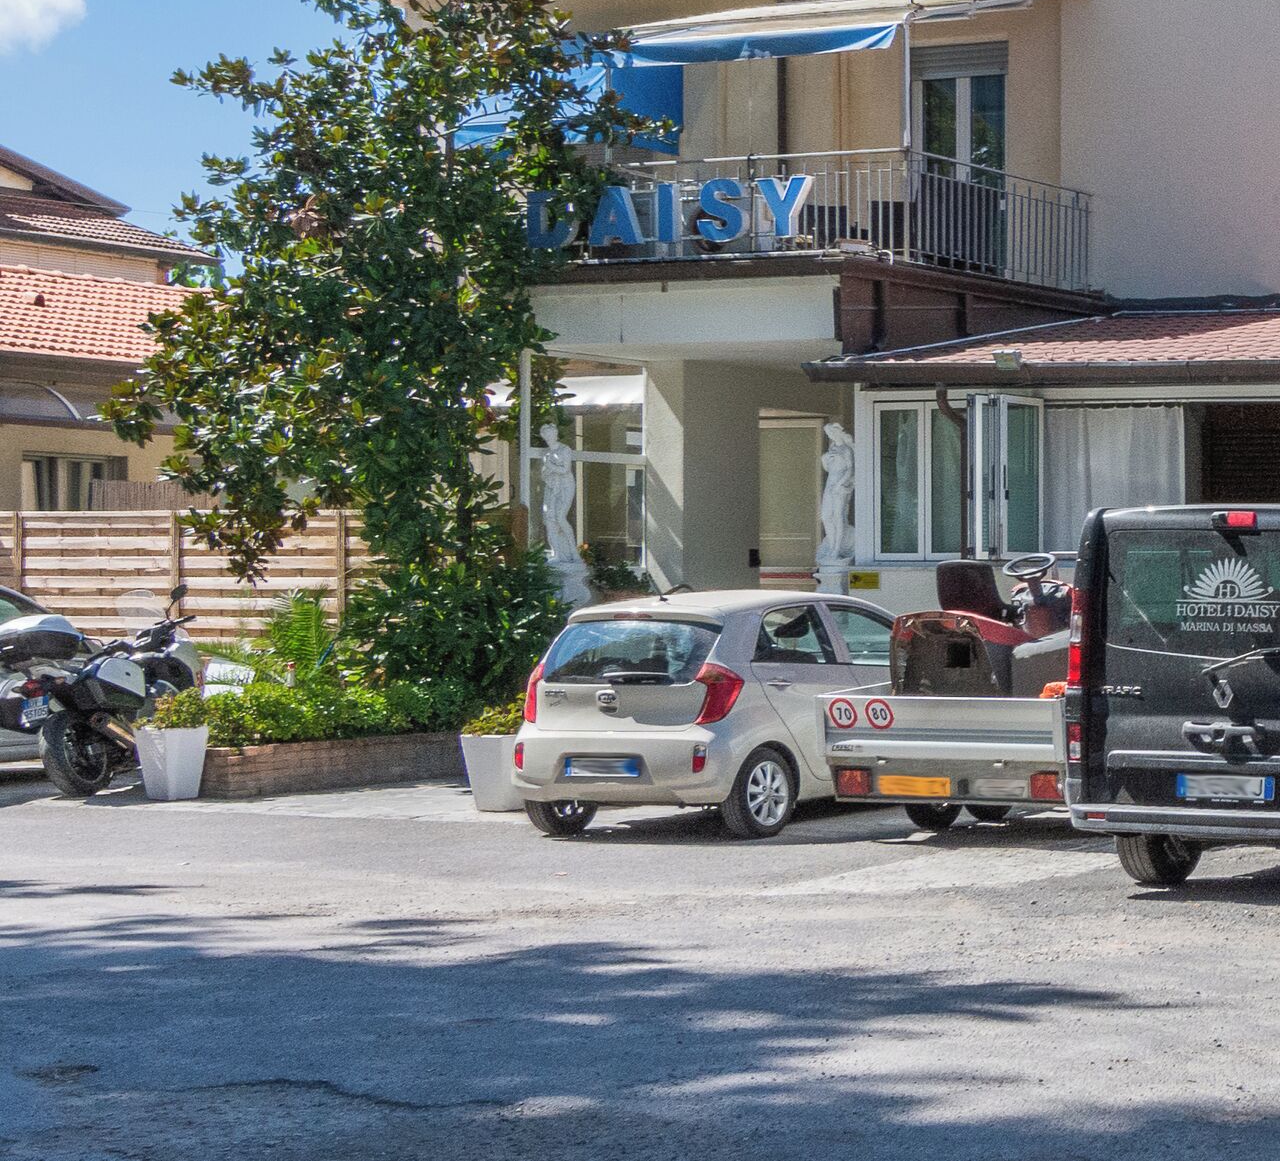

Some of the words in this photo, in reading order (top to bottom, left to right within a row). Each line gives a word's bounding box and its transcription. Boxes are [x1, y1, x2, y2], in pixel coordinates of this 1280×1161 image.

[1176, 603, 1226, 617] HOTEL
[1234, 604, 1280, 618] DAISY
[1180, 621, 1220, 632] MARINA
[1223, 622, 1234, 632] DI
[1236, 623, 1273, 633] MASSA
[836, 707, 852, 721] 70
[871, 707, 888, 721] 80
